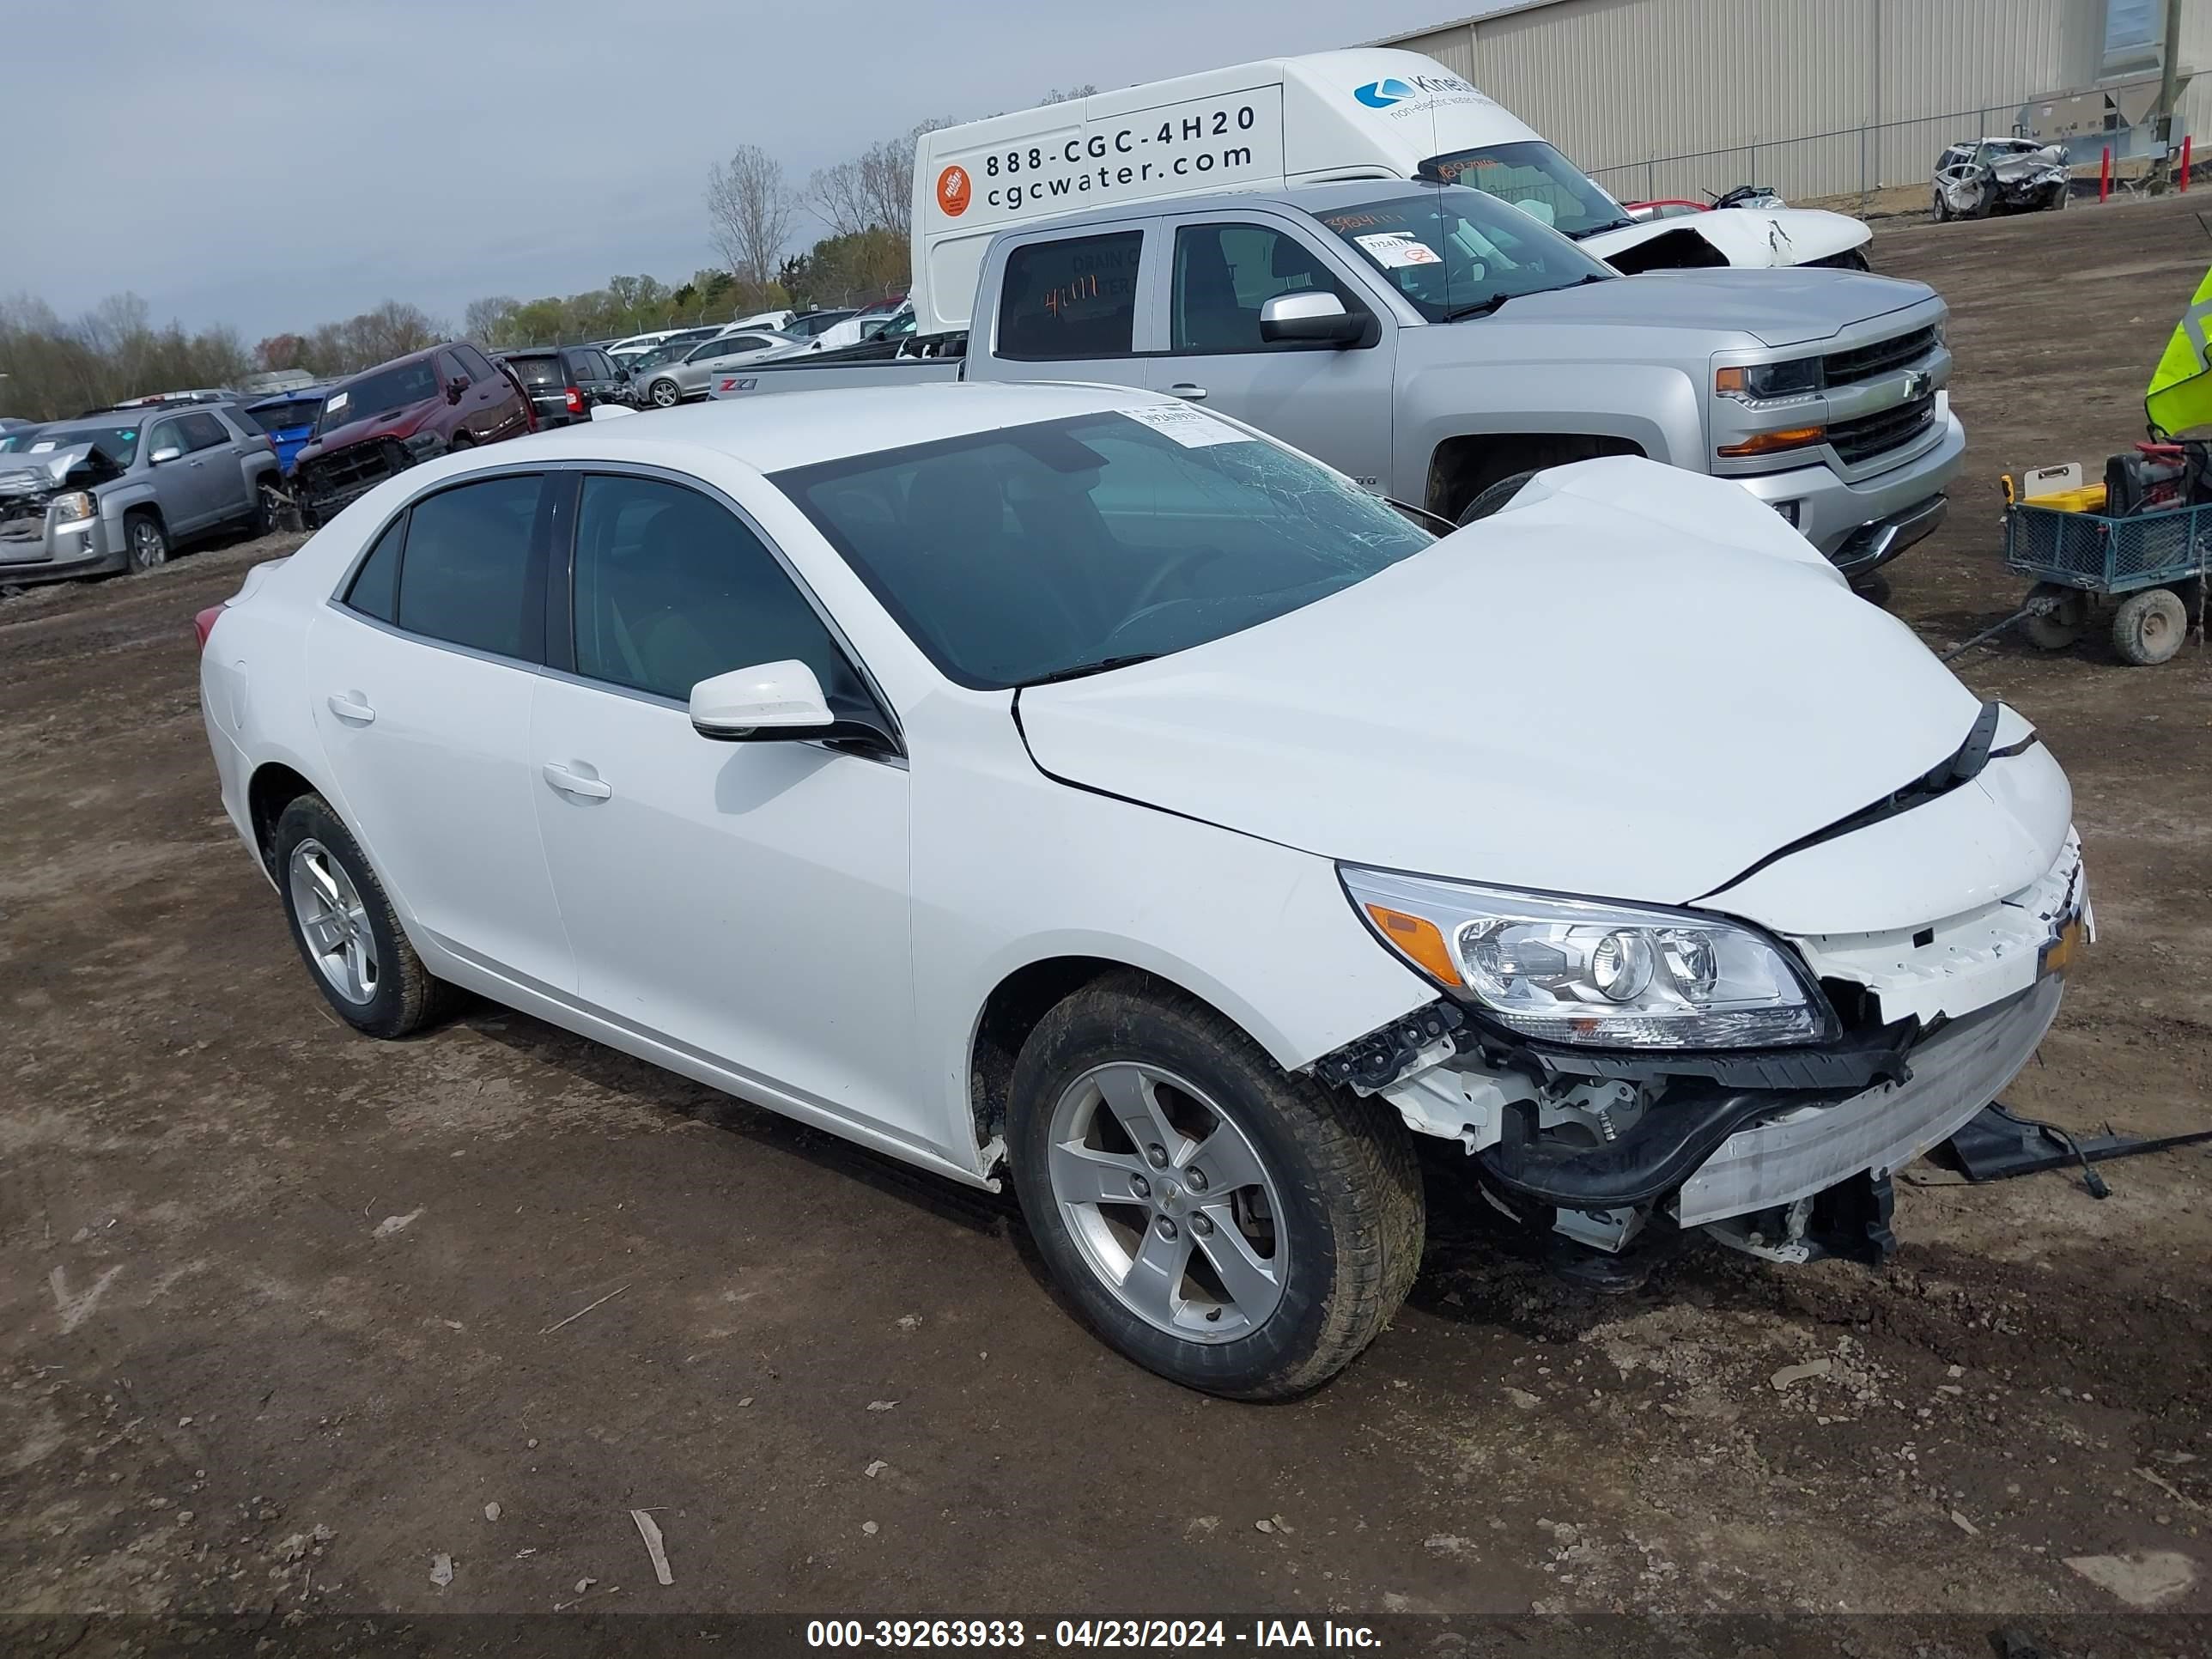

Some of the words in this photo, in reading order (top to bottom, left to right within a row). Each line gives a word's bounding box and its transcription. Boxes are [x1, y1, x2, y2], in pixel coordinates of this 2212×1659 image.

[1389, 96, 1451, 120] non-electric
[987, 106, 1255, 177] 888-CGC-4H20
[988, 146, 1252, 210] cgcwater.com
[719, 378, 758, 392] Z71
